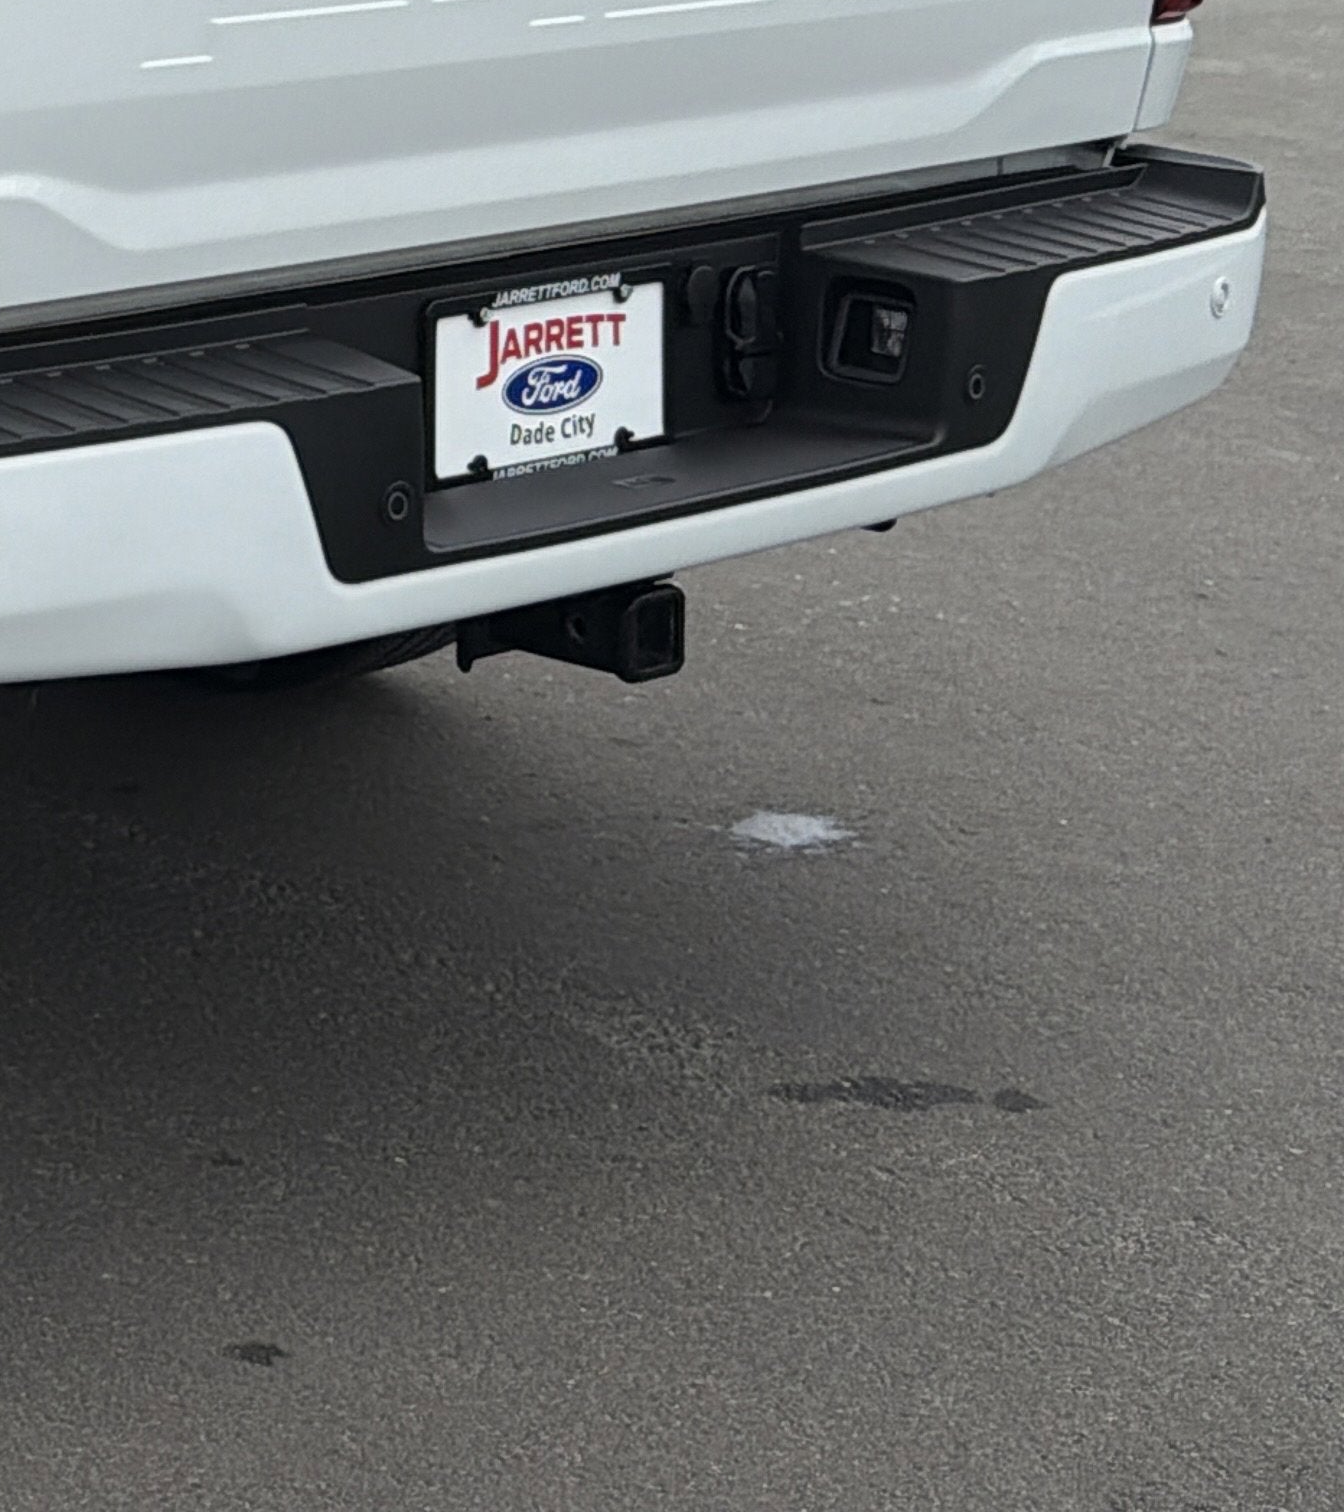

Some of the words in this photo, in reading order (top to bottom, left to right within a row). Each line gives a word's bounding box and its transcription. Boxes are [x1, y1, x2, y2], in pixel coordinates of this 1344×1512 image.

[492, 272, 621, 308] JARRETTFORD.COM
[476, 314, 626, 390] JARRETT
[521, 364, 583, 406] Ford
[510, 422, 555, 445] Dade
[561, 414, 595, 438] City
